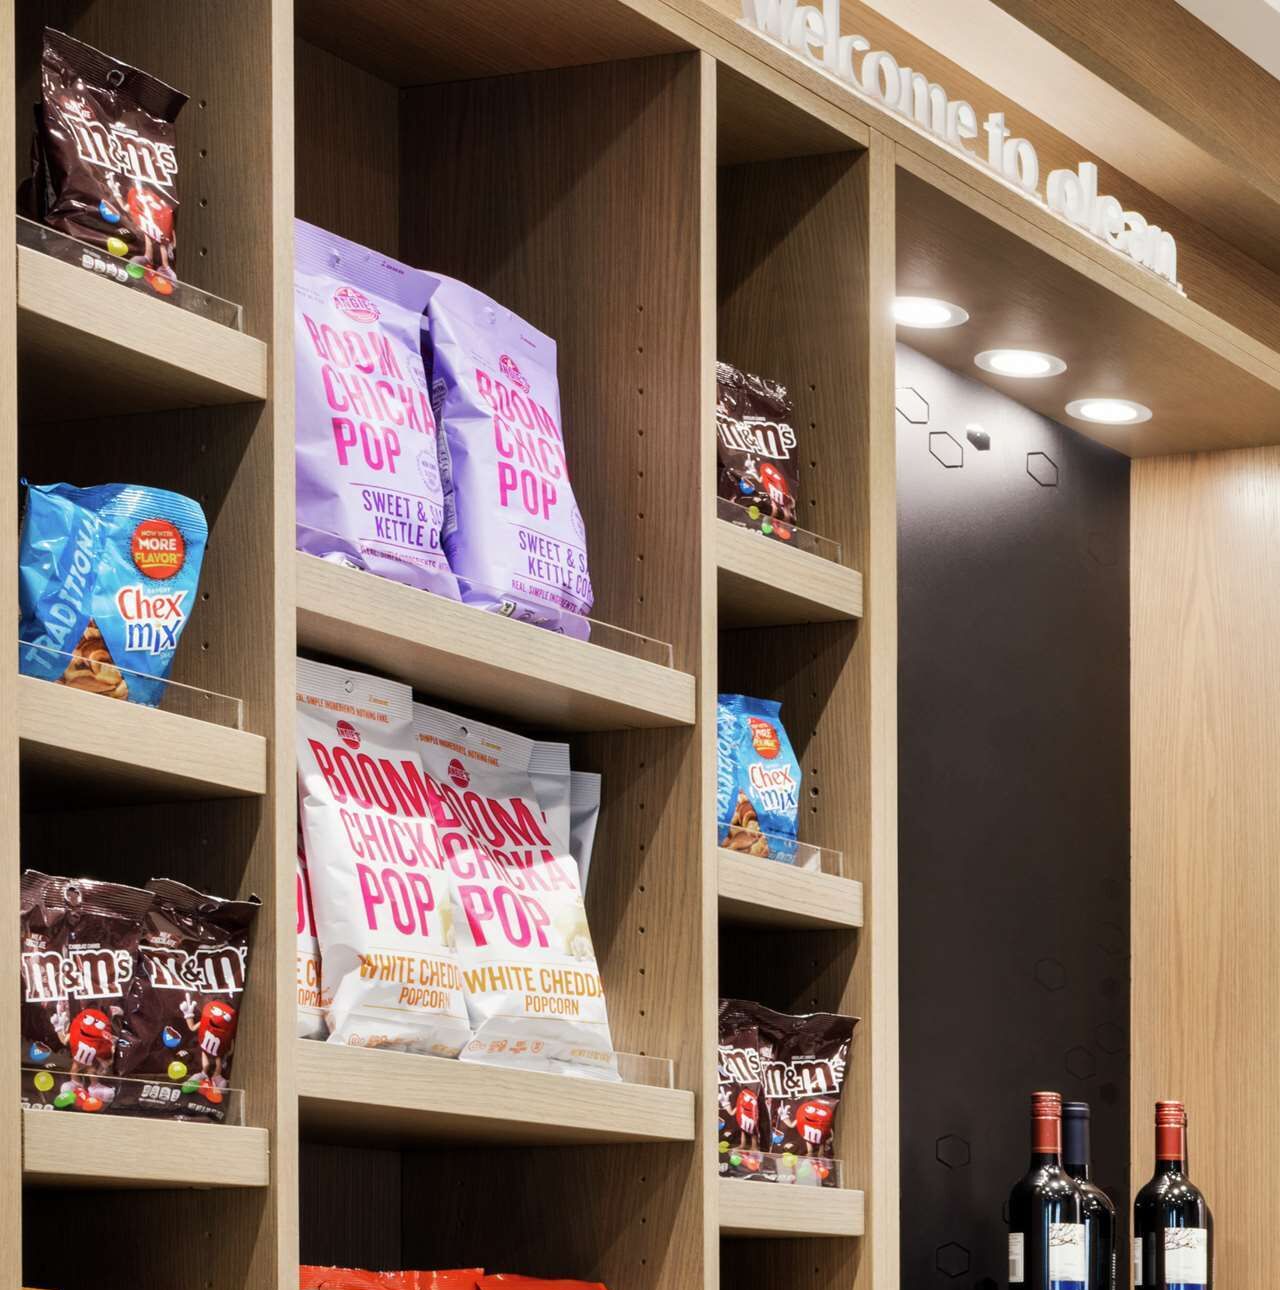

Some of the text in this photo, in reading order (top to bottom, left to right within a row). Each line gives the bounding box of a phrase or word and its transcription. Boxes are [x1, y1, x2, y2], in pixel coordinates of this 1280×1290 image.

[983, 111, 1040, 196] to
[302, 312, 404, 381] BOOM
[322, 364, 436, 435] CHICKA
[475, 369, 561, 442] BOOM
[331, 417, 400, 474] POP
[494, 415, 567, 480] CHIC
[362, 489, 410, 519] SWEET
[417, 501, 428, 523] &
[497, 462, 557, 520] POP
[138, 537, 177, 550] MORE
[375, 516, 424, 547] KETTLE
[519, 530, 560, 563] SWEET
[567, 548, 575, 568] &
[135, 552, 178, 565] FLAVOR
[528, 555, 572, 590] KETTLE
[25, 517, 104, 671] TRADITIONA
[117, 585, 187, 621] Chex
[126, 620, 181, 655] mix
[307, 738, 428, 818] BOOM
[750, 764, 793, 789] Chex
[340, 807, 444, 870] CHICKA
[356, 864, 435, 936] POP
[459, 884, 550, 948] POP
[359, 953, 414, 984] WHITE
[464, 967, 536, 995] WHITE
[525, 995, 579, 1016] POPCORN
